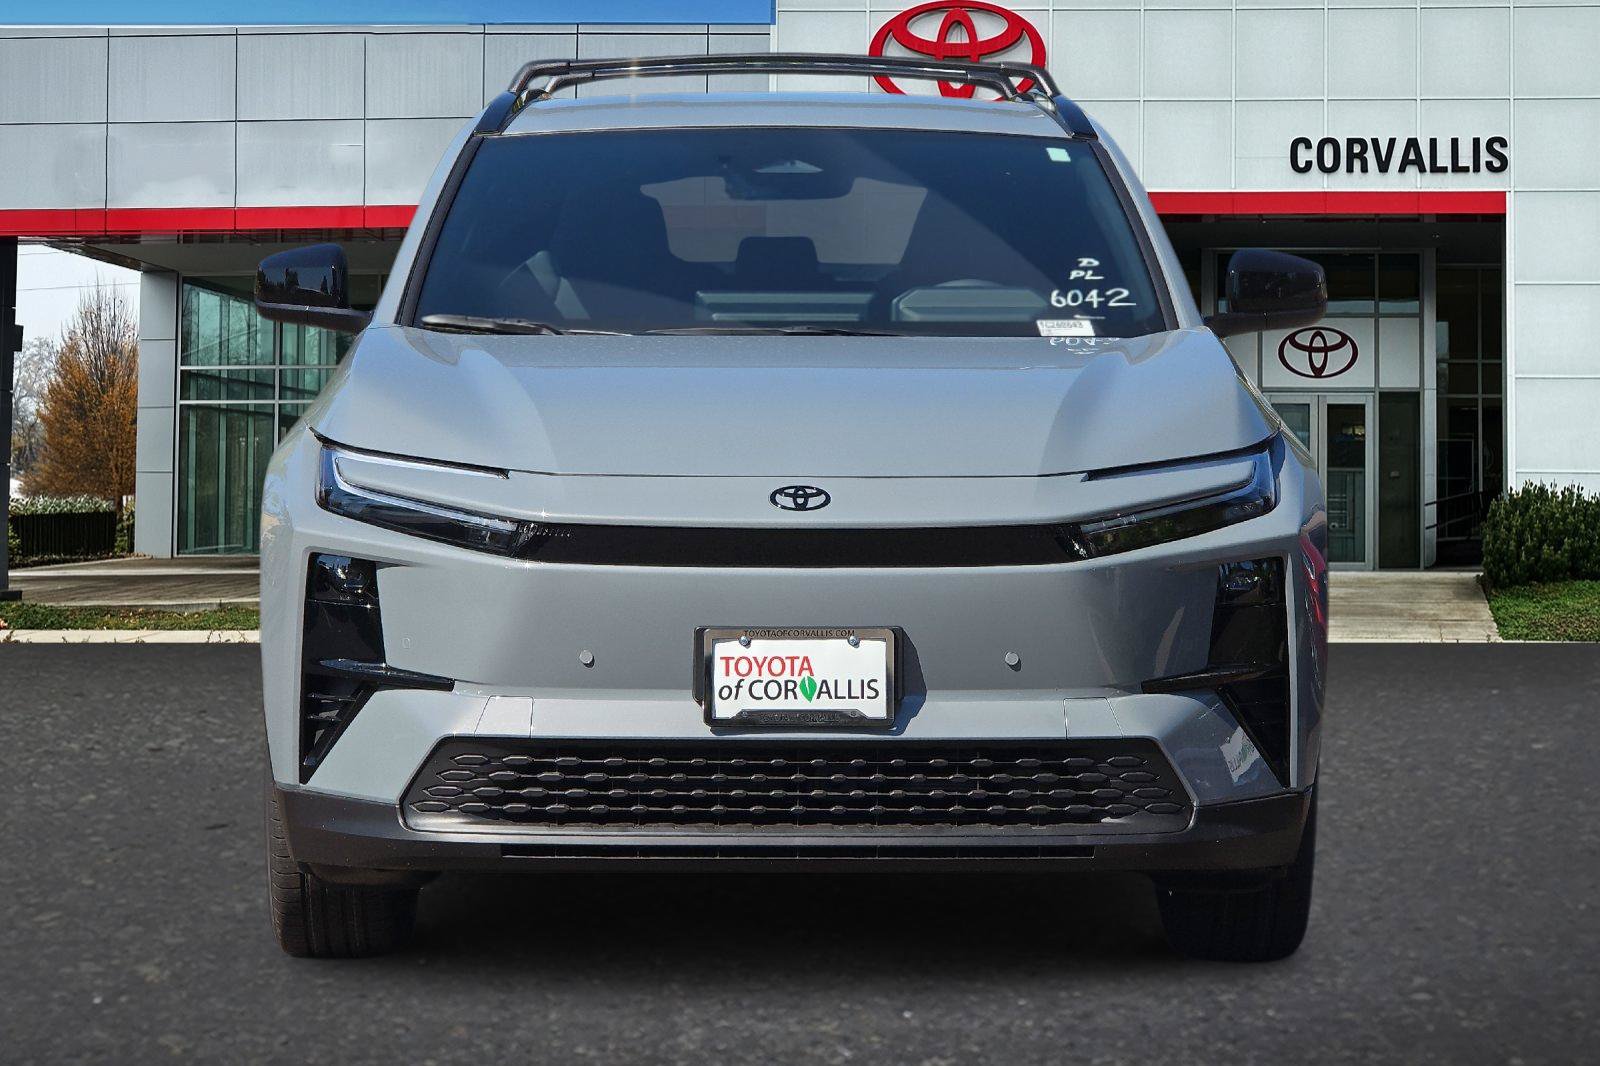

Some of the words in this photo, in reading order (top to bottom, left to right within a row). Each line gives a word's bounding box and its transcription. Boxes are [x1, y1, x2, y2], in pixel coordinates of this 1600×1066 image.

[1290, 137, 1508, 174] CORVALLIS
[1069, 269, 1104, 280] PL
[1050, 287, 1137, 309] 6042
[719, 656, 815, 677] TOYOTA
[718, 678, 745, 701] of
